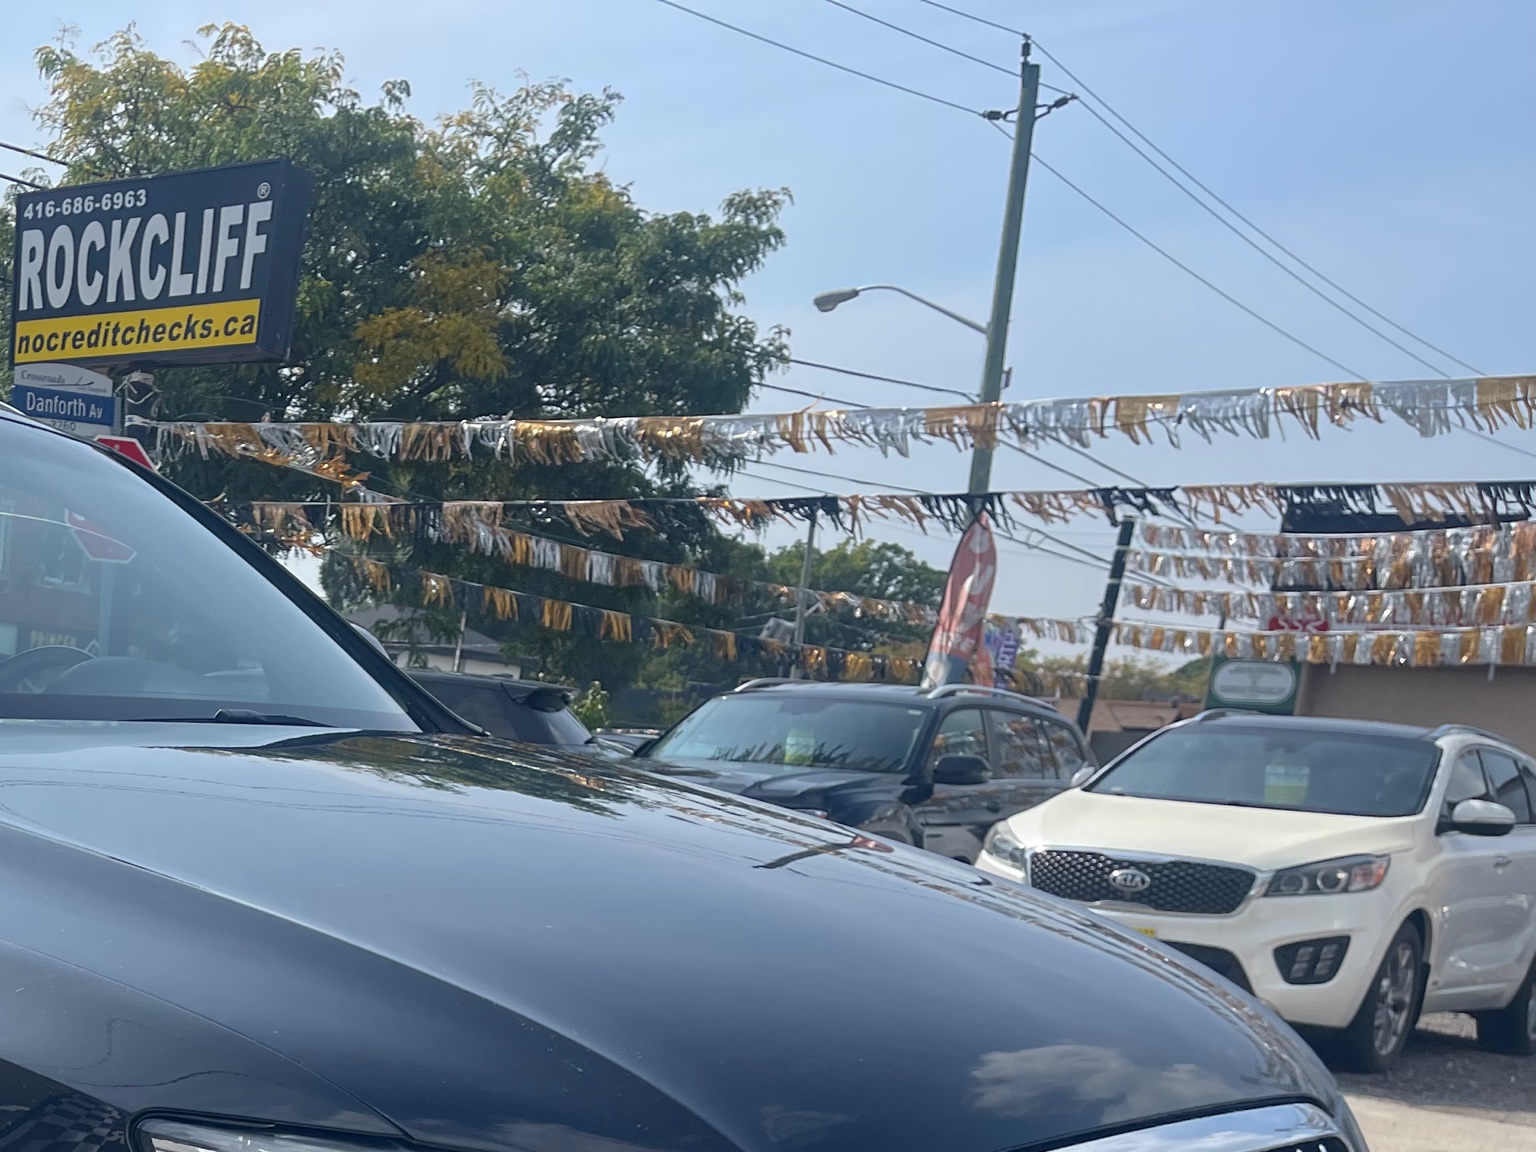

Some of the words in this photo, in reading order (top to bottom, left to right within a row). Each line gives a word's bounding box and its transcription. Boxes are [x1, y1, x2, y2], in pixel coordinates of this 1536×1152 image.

[24, 189, 147, 220] 416-686-6963
[18, 200, 273, 311] ROCKCLIFF
[17, 313, 255, 354] nocreditchecks.ca
[26, 392, 86, 417] Danforth
[89, 403, 104, 419] Av
